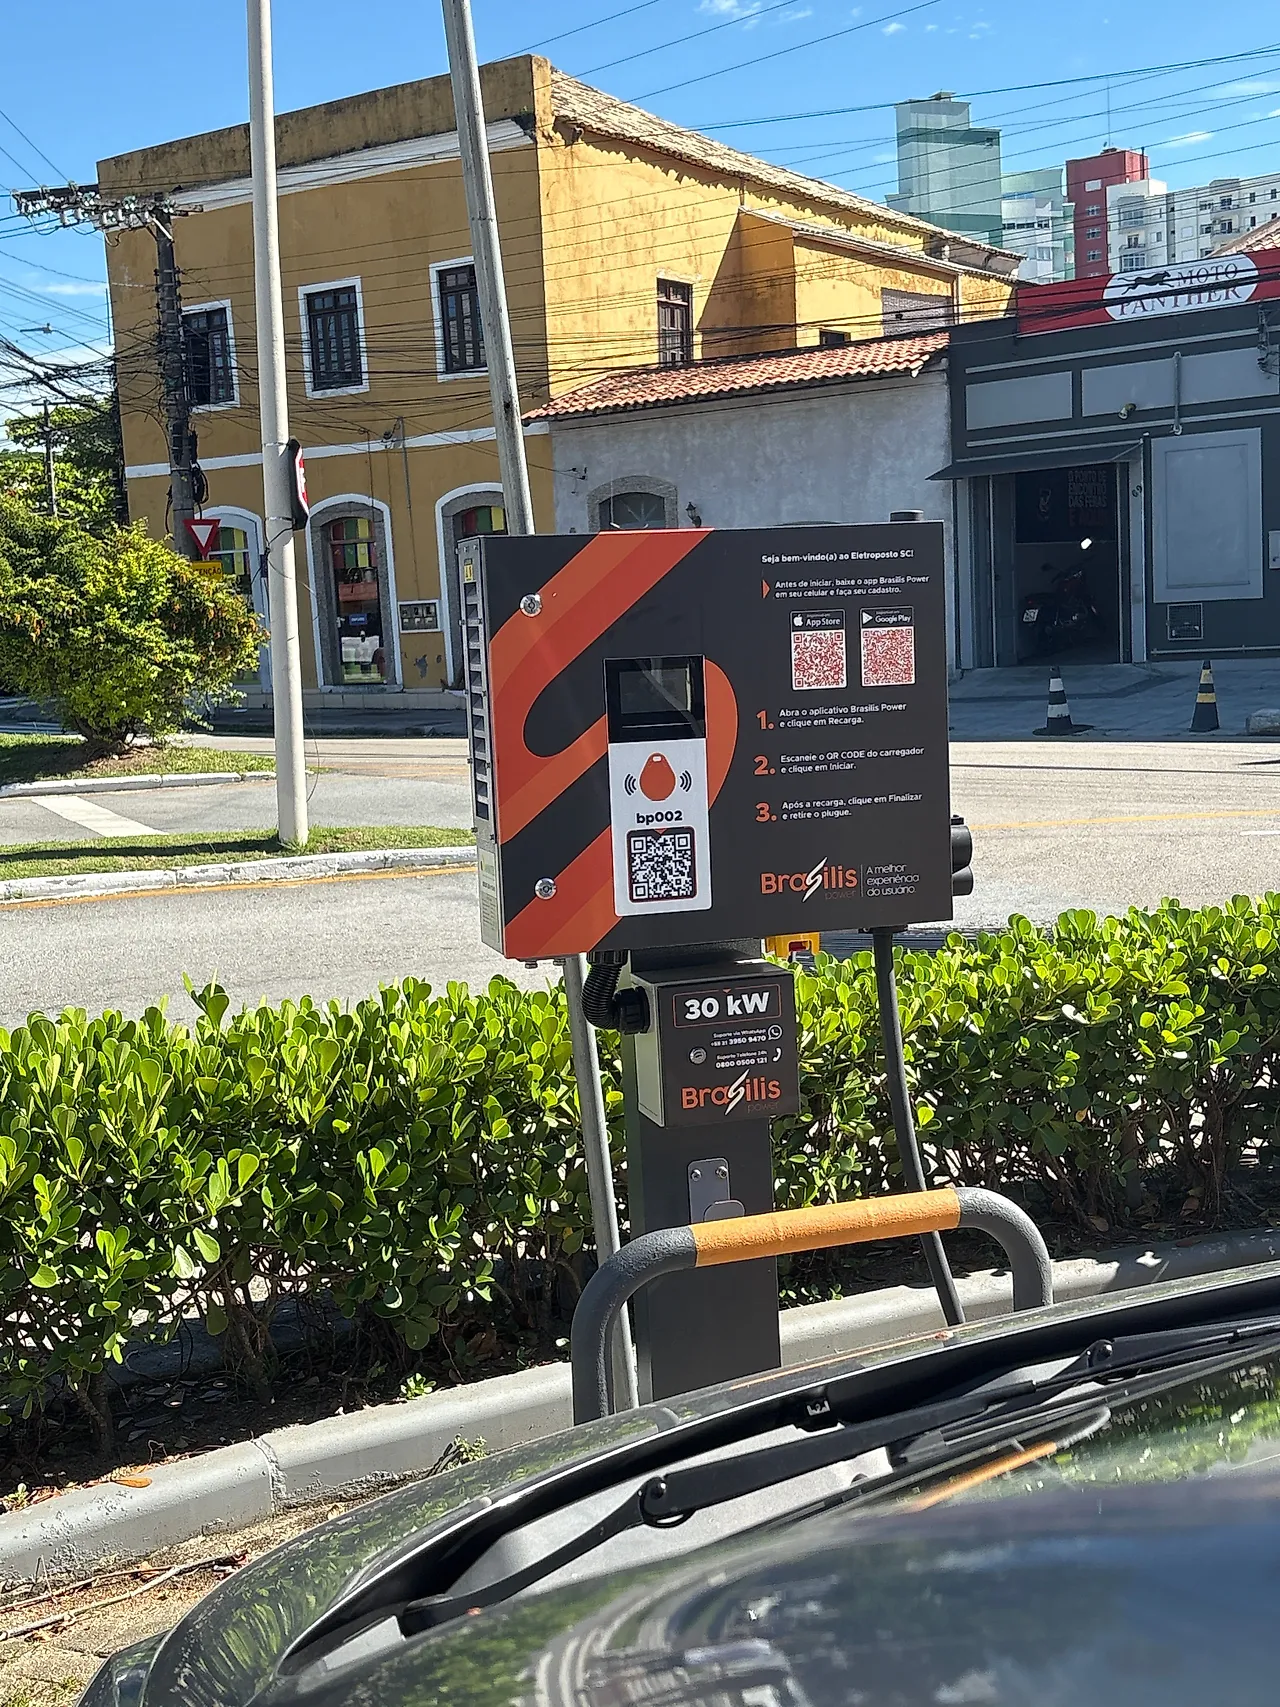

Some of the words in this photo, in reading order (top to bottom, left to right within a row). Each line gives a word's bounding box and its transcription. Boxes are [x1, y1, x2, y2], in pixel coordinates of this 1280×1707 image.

[1177, 263, 1238, 287] MOTO
[1119, 284, 1242, 316] PANTHER
[762, 554, 779, 564] Seja
[781, 553, 837, 562] bem-vindo(a)
[850, 551, 898, 560] Eletroposto
[900, 549, 914, 557] SC!
[835, 578, 855, 586] baixe
[863, 578, 878, 586] app
[879, 576, 905, 584] Brasilis
[906, 575, 929, 583] Power
[803, 589, 828, 597] celular
[835, 588, 852, 597] faça
[868, 586, 901, 594] cadastro.
[806, 618, 820, 627] App
[822, 617, 841, 626] Store
[875, 615, 897, 624] Google
[898, 614, 911, 622] Play
[779, 708, 800, 717] Abra
[809, 706, 848, 717] aplicativo
[850, 704, 879, 713] Brasilis
[881, 703, 907, 711] Power
[756, 710, 774, 730] 1.
[786, 718, 811, 728] clique
[828, 716, 864, 726] Recarga.
[780, 753, 816, 763] Escaneie
[826, 752, 839, 761] QR
[840, 750, 865, 760] CODE
[866, 750, 877, 758] do
[879, 747, 924, 758] carregador
[753, 755, 775, 775] 2.
[788, 764, 812, 774] clique
[829, 762, 856, 771] Iniciar.
[782, 801, 804, 811] Após
[812, 799, 846, 809] recarga,
[847, 795, 872, 805] clique
[888, 792, 922, 802] Finalizar
[636, 810, 682, 825] bp002
[755, 803, 776, 822] 3.
[789, 811, 812, 819] retire
[821, 809, 851, 819] plugue.
[866, 866, 873, 875] A
[874, 863, 906, 874] melhor
[760, 856, 858, 902] Brasilis
[867, 887, 880, 896] do
[684, 997, 719, 1020] 30
[726, 991, 769, 1016] kW
[681, 1068, 781, 1115] Brasilis
